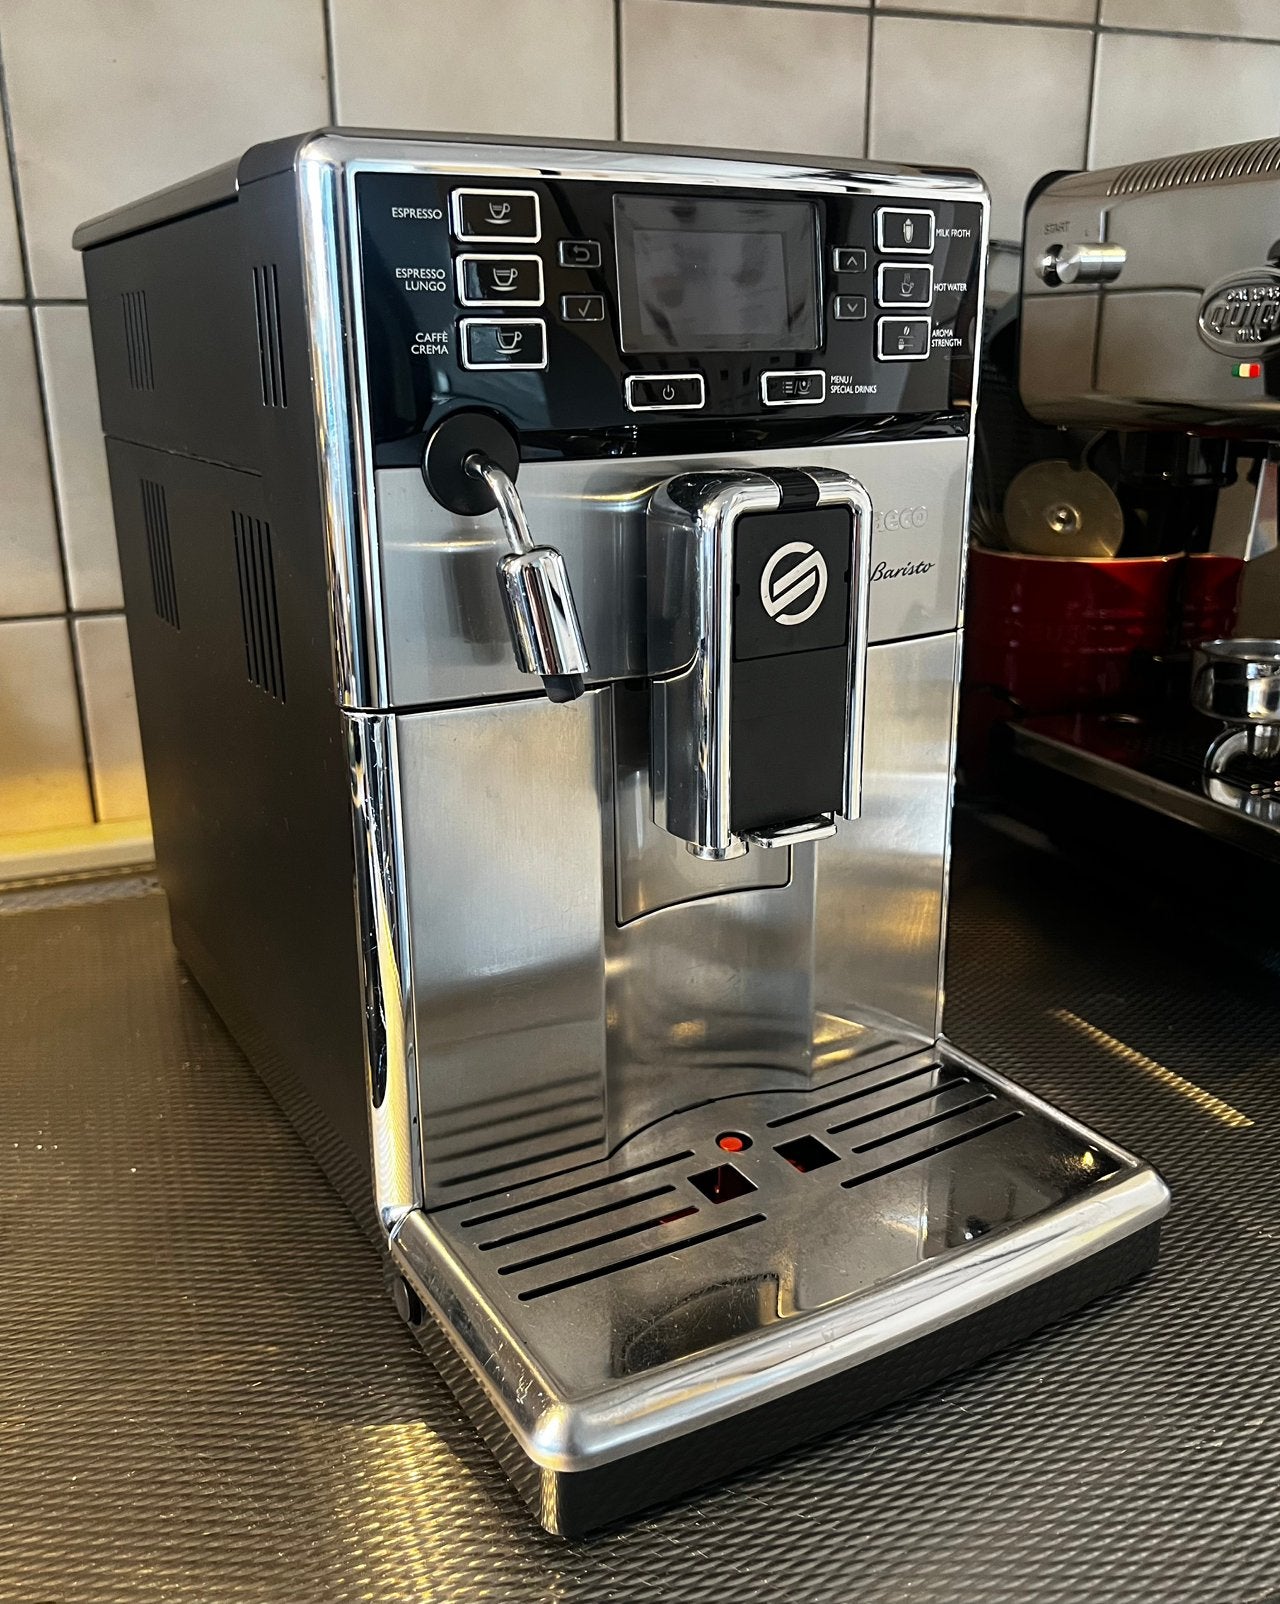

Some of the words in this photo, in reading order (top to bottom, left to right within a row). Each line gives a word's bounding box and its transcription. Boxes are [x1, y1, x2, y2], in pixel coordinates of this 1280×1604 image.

[391, 207, 443, 220] ESPRESSO
[935, 229, 950, 237] MILK
[951, 229, 971, 238] FROTH
[395, 268, 446, 280] ESPRESSO
[405, 281, 447, 292] LUNGO
[933, 283, 947, 292] HOT
[947, 283, 968, 292] WATER
[415, 331, 449, 343] CAFFÈ
[931, 329, 954, 337] AROMA
[931, 339, 962, 347] STRENGTH
[411, 345, 449, 355] CREMA
[830, 385, 854, 394] SPECIAL
[854, 384, 877, 394] DRINKS
[870, 561, 936, 581] Baristo
